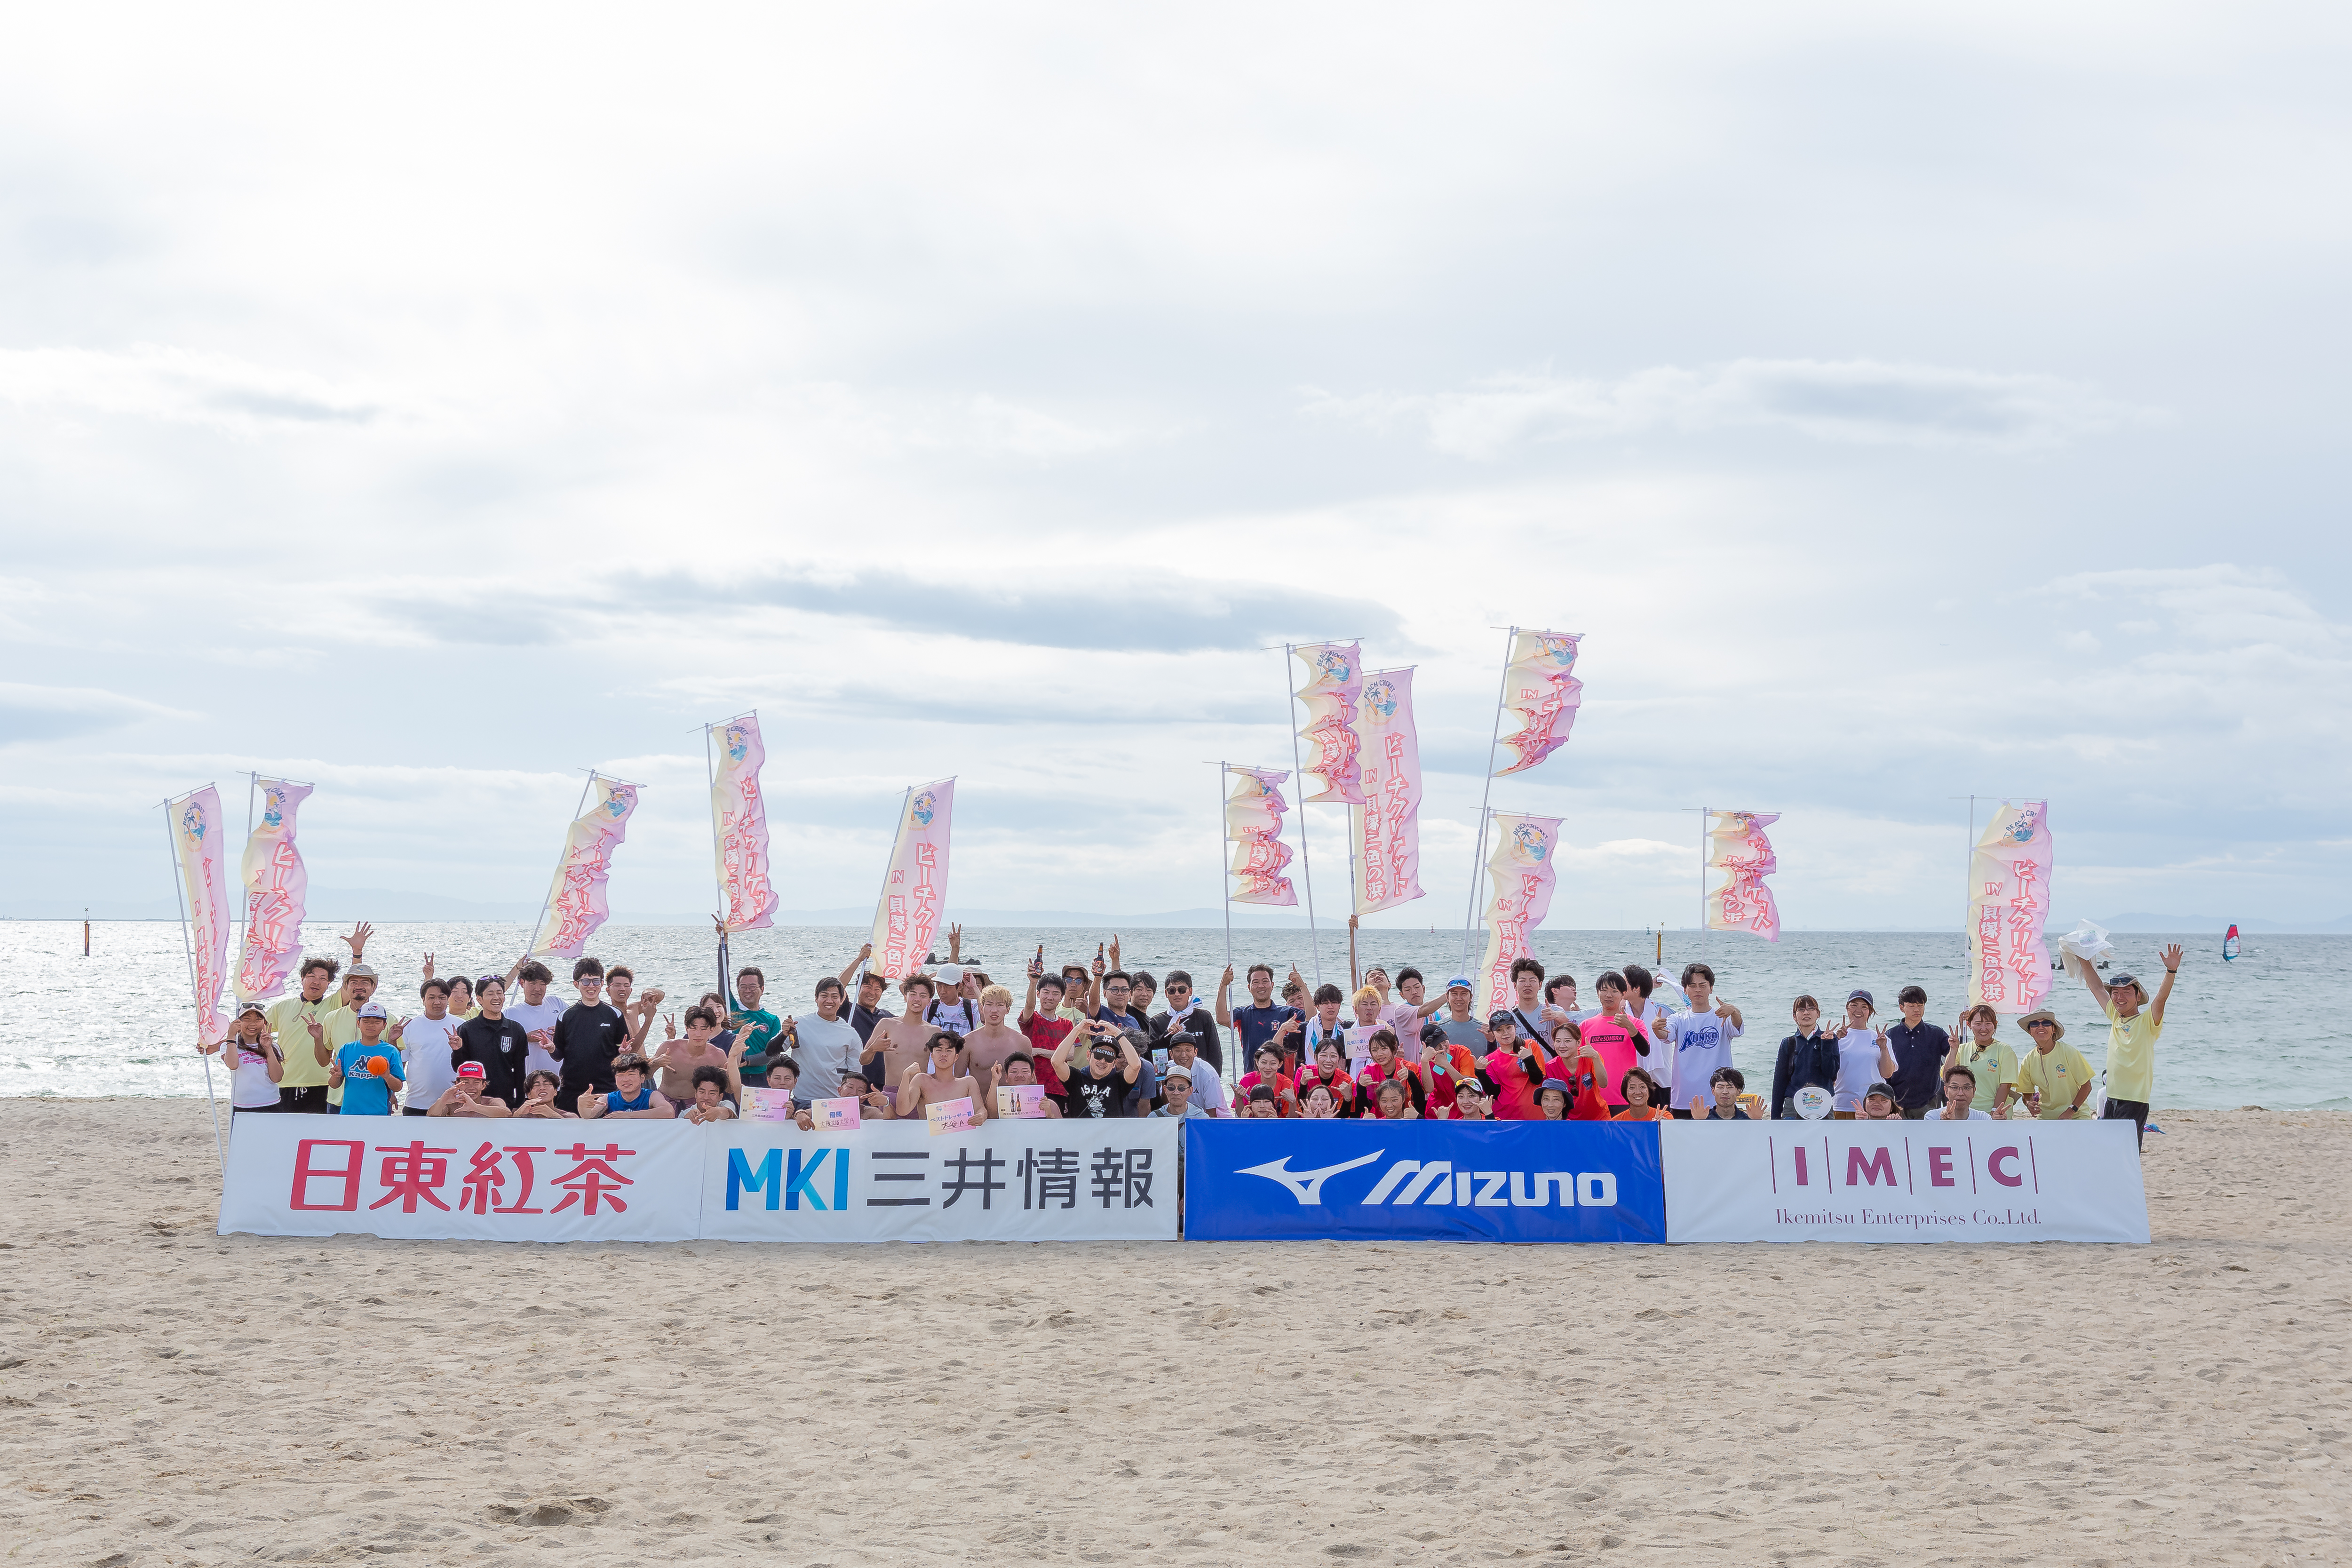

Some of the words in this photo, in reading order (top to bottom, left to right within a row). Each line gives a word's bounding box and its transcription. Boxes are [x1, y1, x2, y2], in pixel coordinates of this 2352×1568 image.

[1364, 681, 1378, 699] BEACH
[1379, 679, 1396, 692] CRICKET
[1521, 688, 1539, 700] IN
[1365, 767, 1377, 784] IN
[183, 805, 192, 827] BEACH
[723, 810, 737, 826] IN
[1385, 732, 1409, 898] ビーチクリケット
[1513, 822, 1527, 836] BEACH
[1526, 823, 1549, 839] CRICKET
[1364, 794, 1386, 902] 貝塚二色の浜
[891, 870, 905, 884] IN
[1985, 882, 2002, 896] IN
[1497, 898, 1512, 911] IN
[1978, 905, 2006, 1003] 貝塚二色の浜
[1679, 1030, 1718, 1052] KONKO
[1081, 1084, 1111, 1098] SAA
[930, 1111, 972, 1122] ベストドレッサー賞
[290, 1139, 637, 1216] 日東紅茶
[725, 1148, 850, 1212] MKI
[866, 1147, 1154, 1211] 三井情報
[1775, 1209, 1855, 1225] Ikemitsu
[1861, 1209, 1967, 1230] Enterprises
